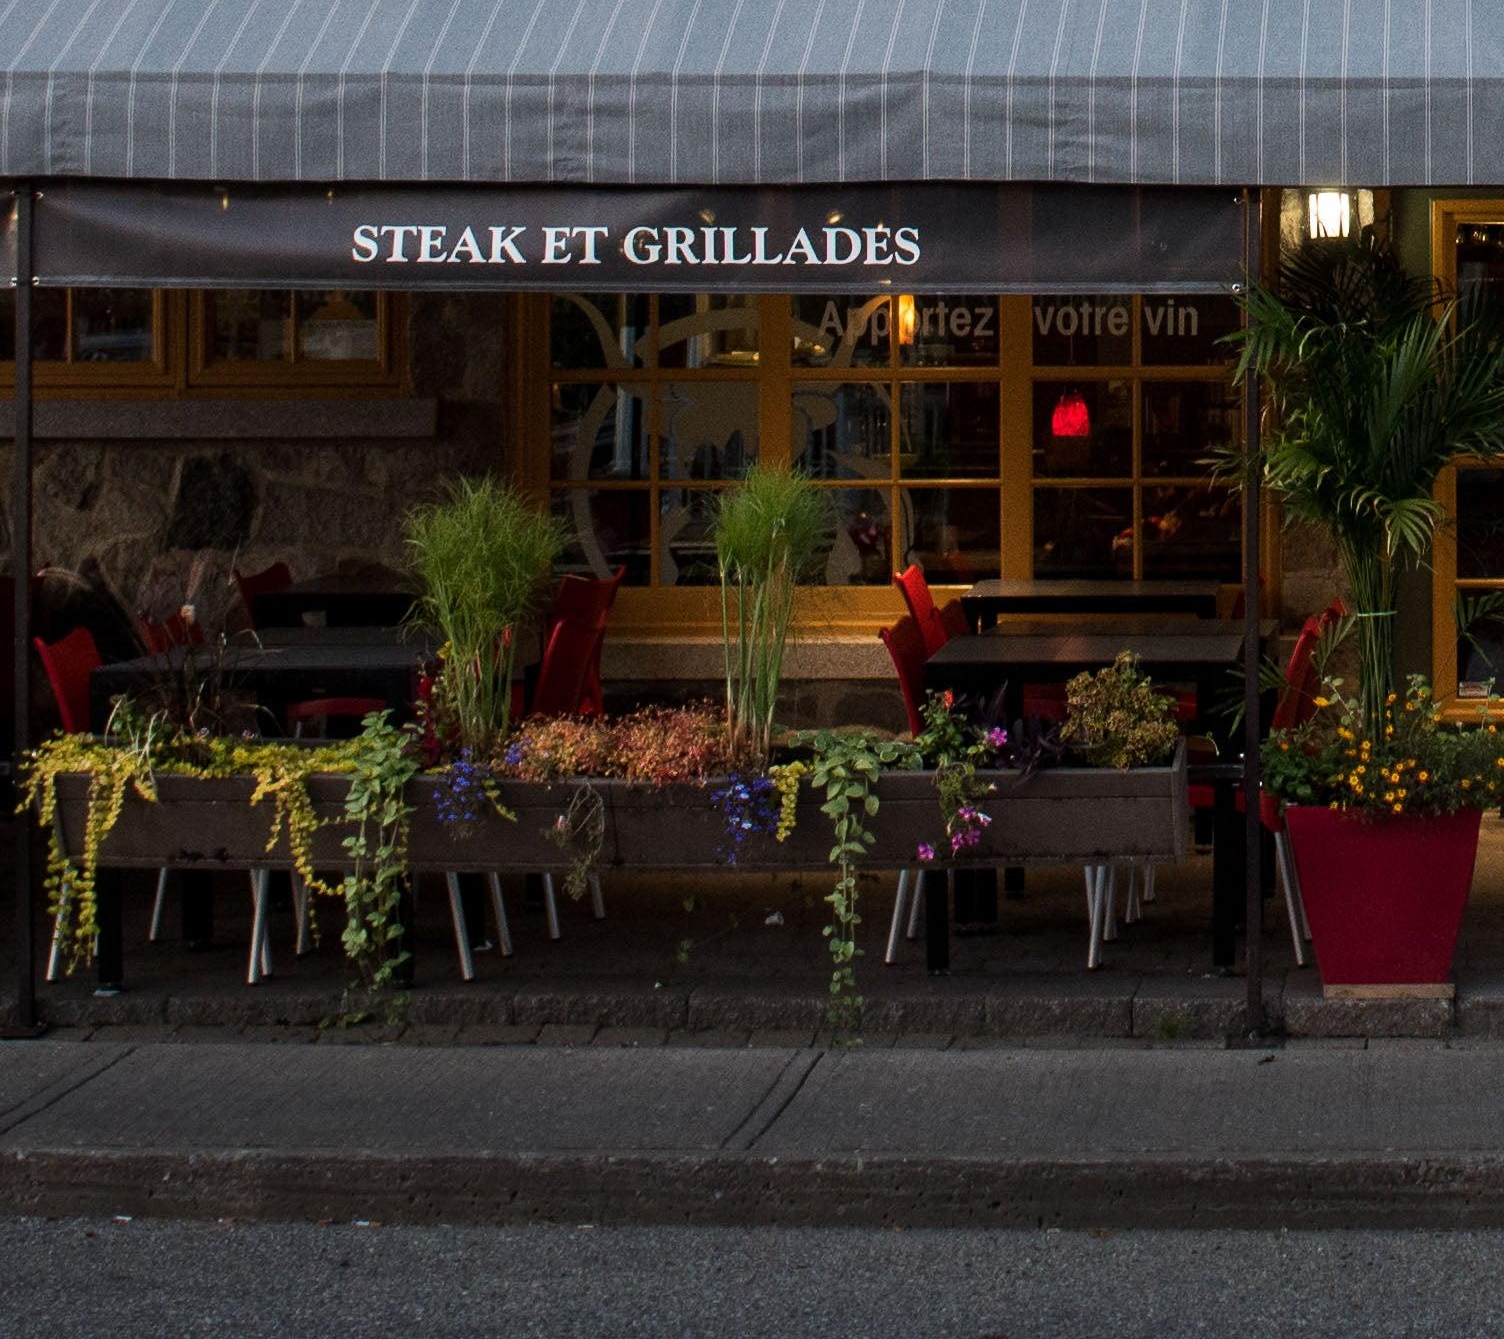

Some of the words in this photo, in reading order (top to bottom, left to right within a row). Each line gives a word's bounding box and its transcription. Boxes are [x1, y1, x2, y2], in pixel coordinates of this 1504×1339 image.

[351, 225, 527, 264] STEAK
[541, 225, 610, 264] ET
[623, 224, 922, 266] GRILLADES
[1033, 301, 1130, 337] votre
[1144, 299, 1199, 336] vin
